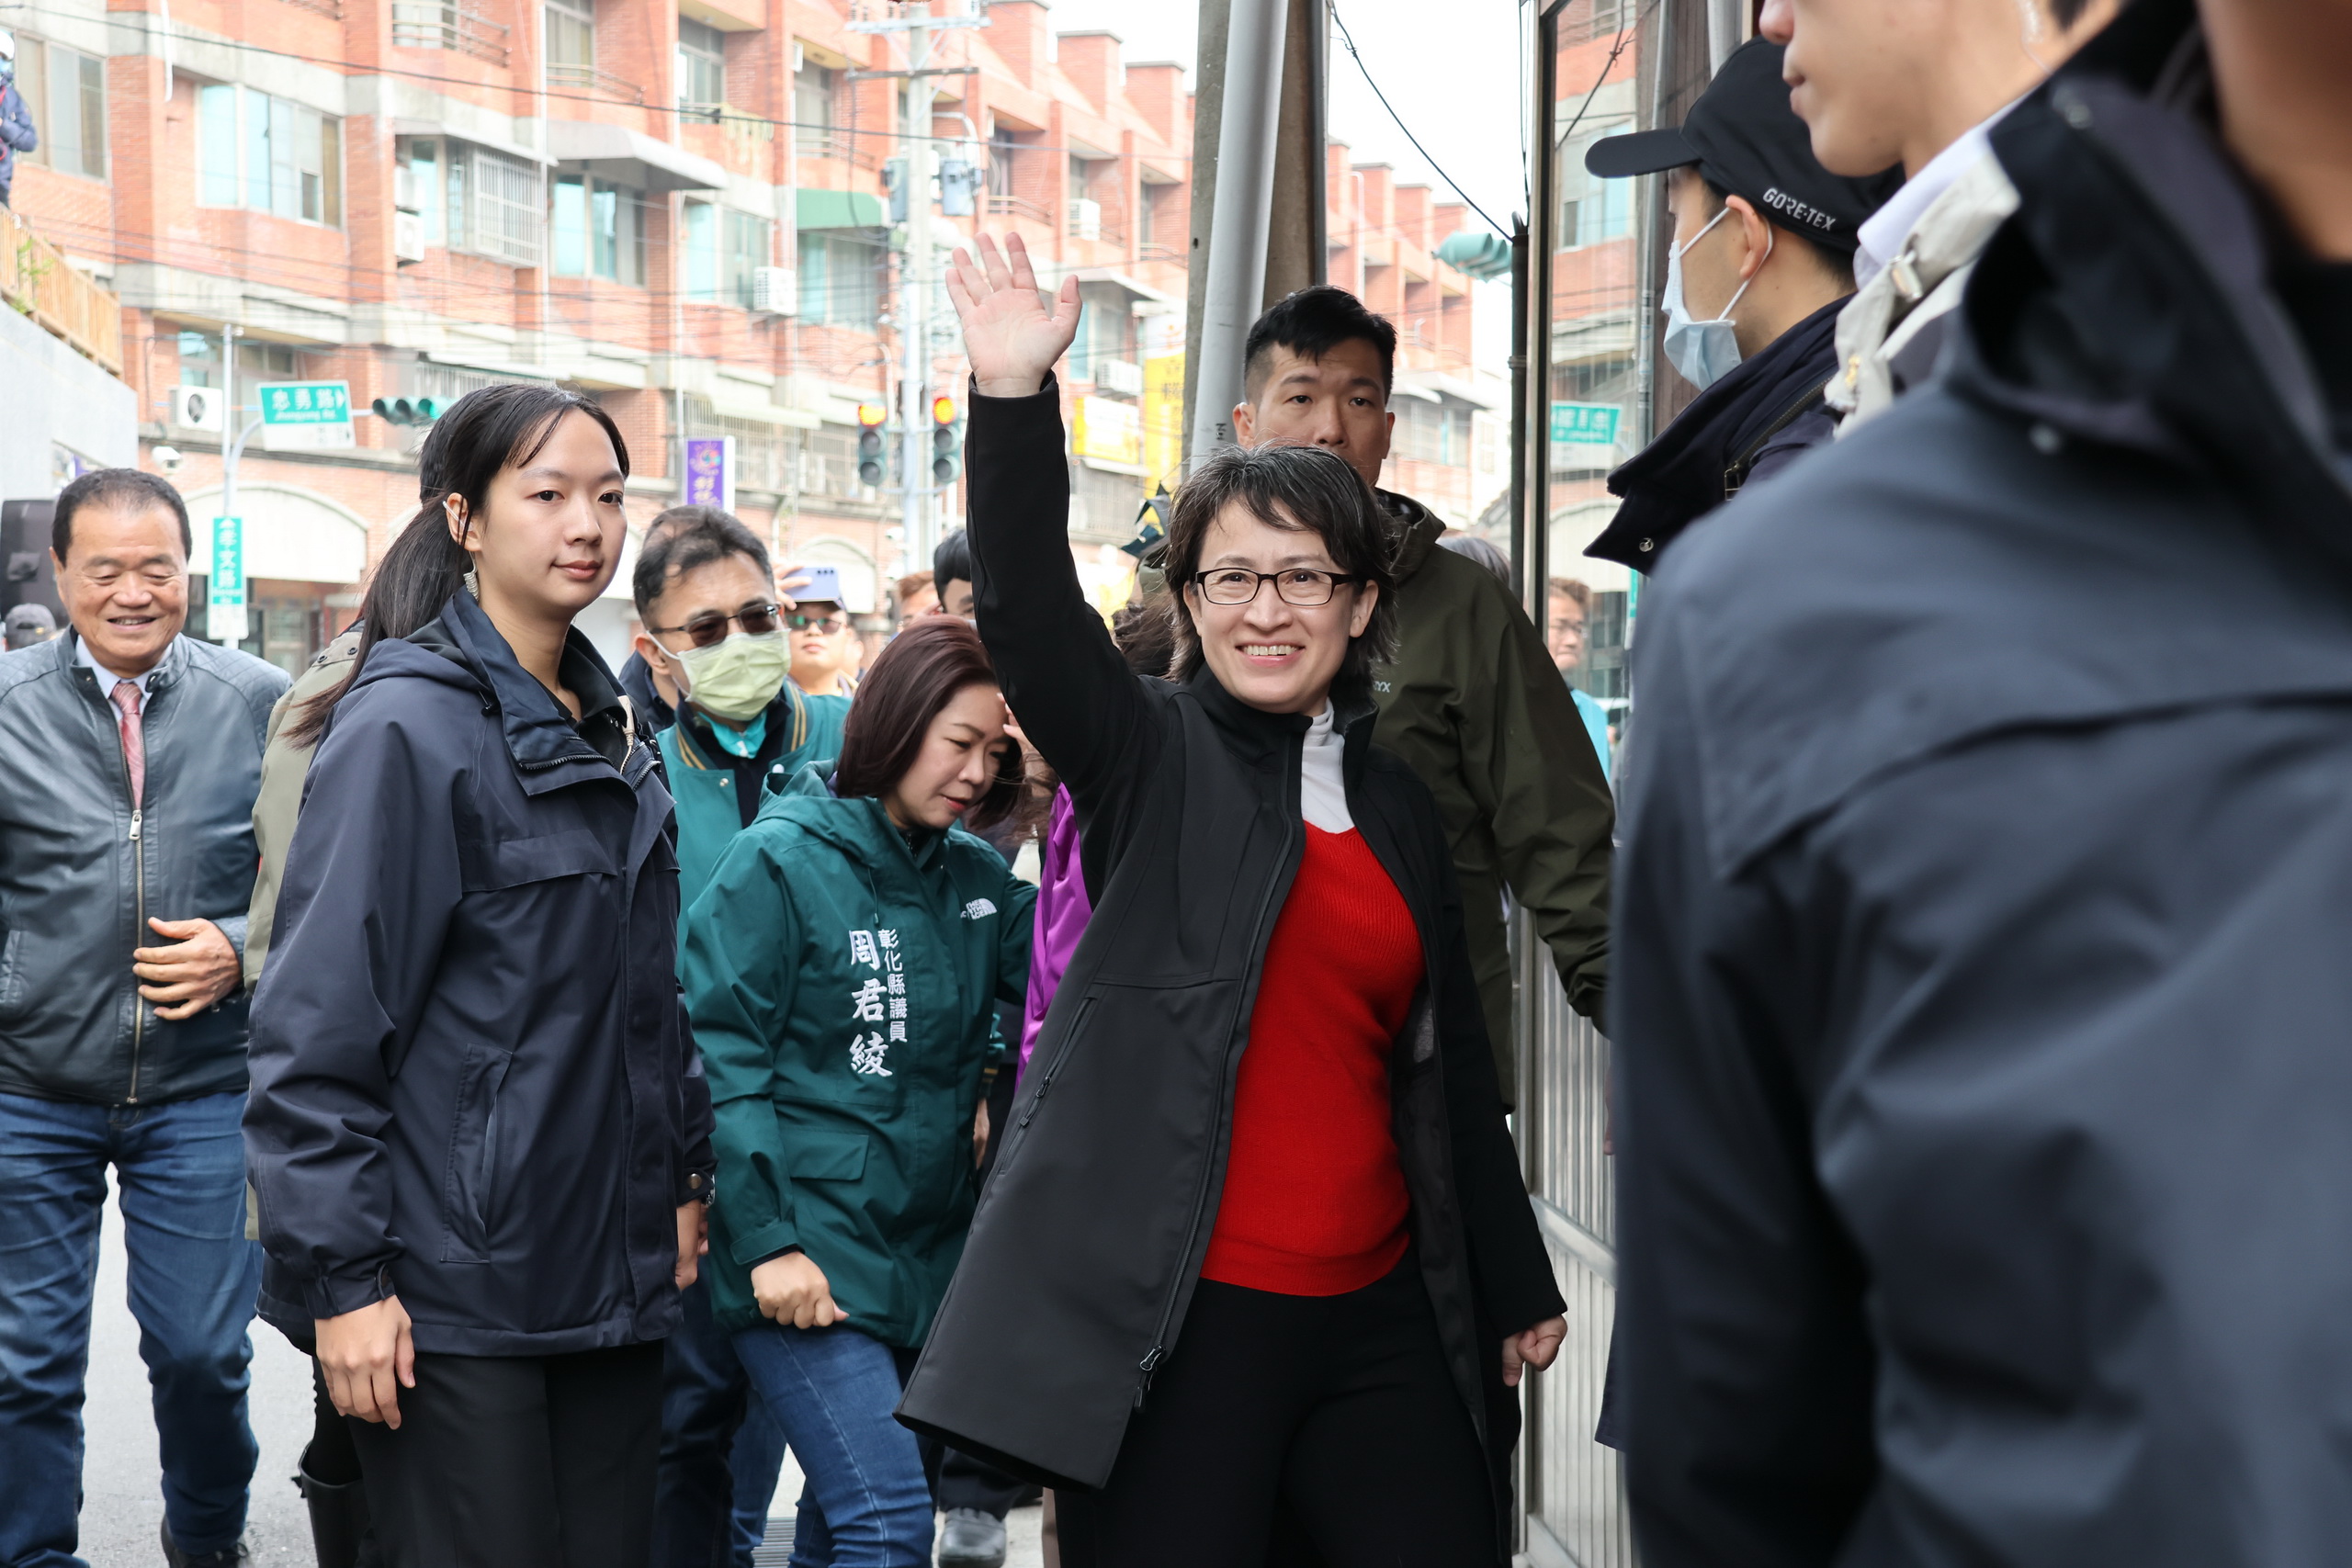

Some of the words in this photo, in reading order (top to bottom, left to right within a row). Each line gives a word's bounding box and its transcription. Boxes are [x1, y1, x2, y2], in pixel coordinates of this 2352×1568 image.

[272, 388, 334, 412] 忠勇路
[877, 929, 908, 1043] 彰化縣議員
